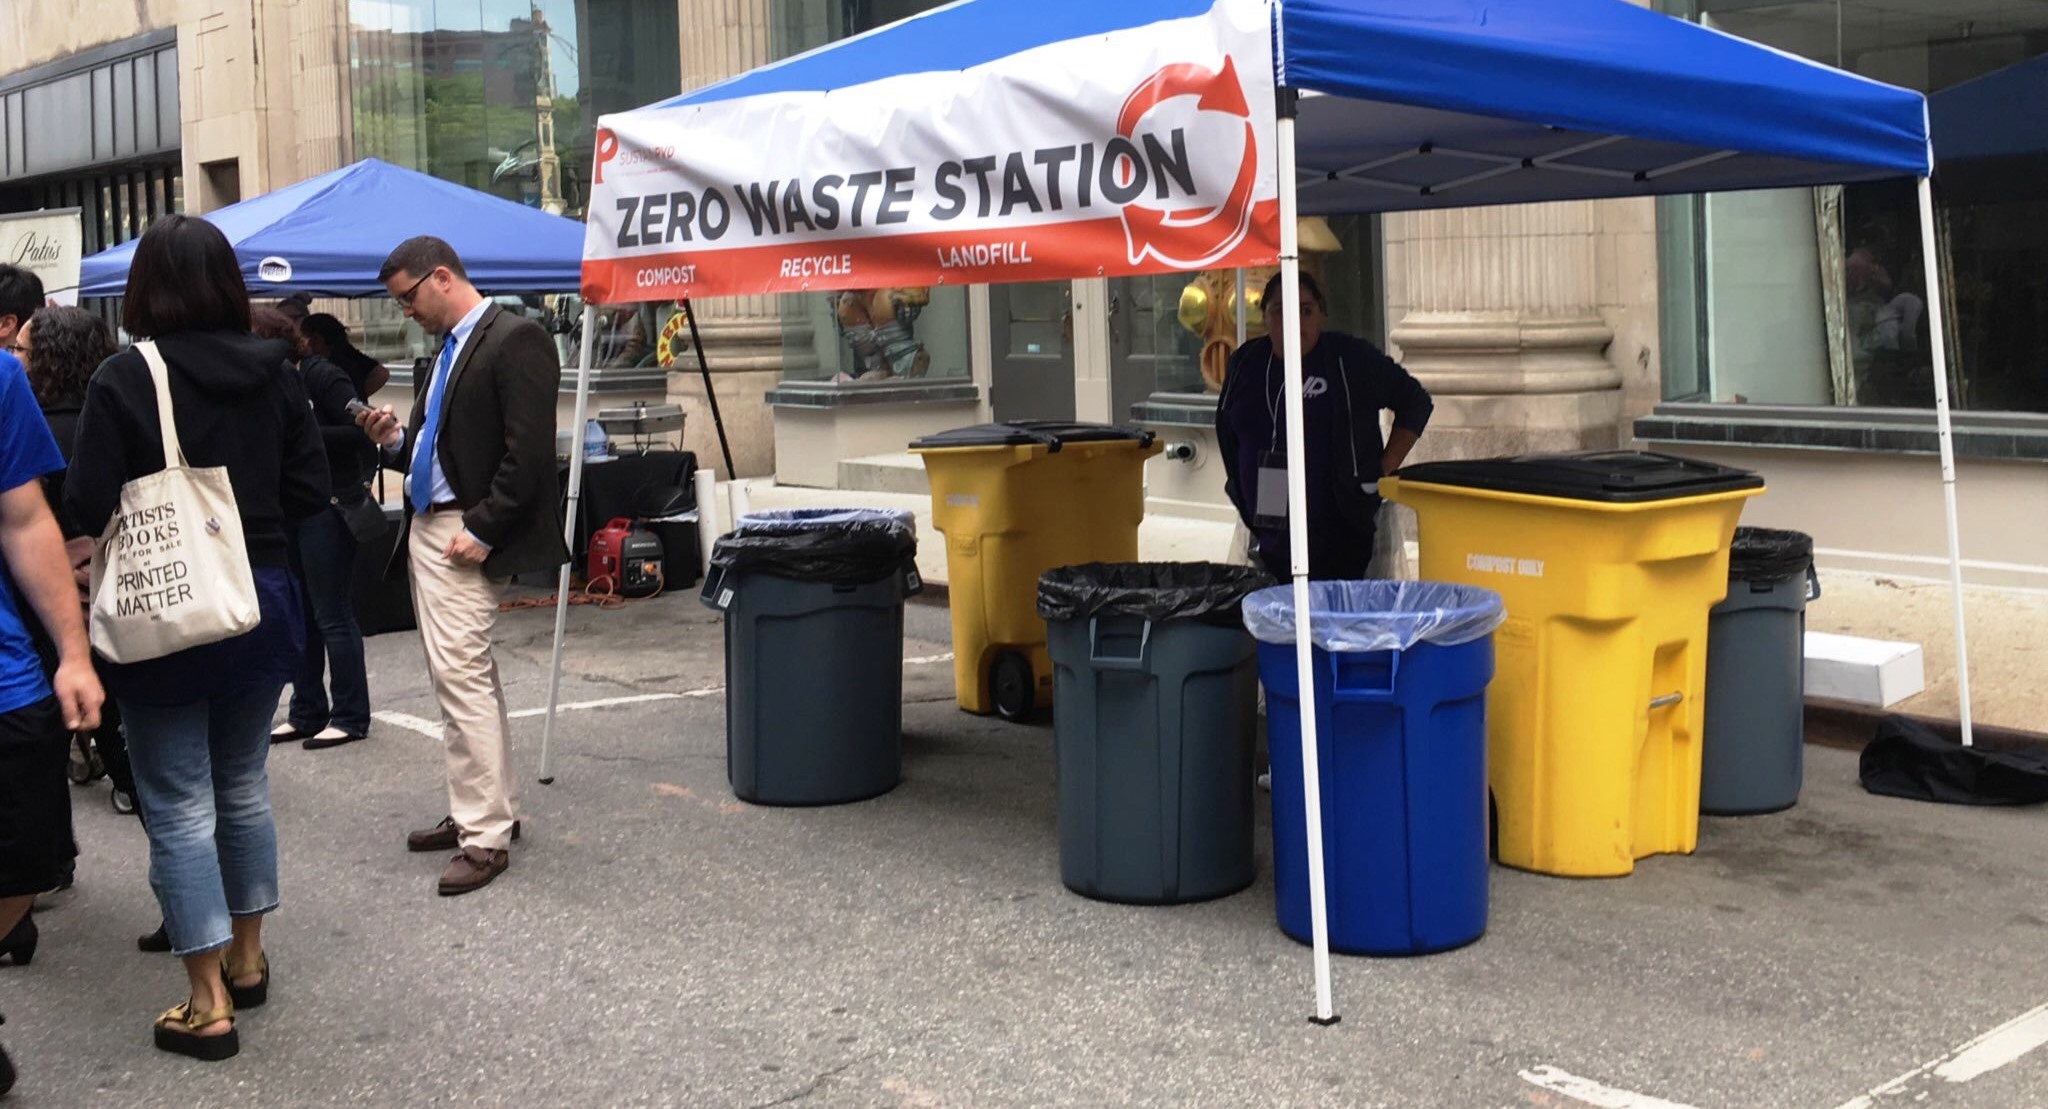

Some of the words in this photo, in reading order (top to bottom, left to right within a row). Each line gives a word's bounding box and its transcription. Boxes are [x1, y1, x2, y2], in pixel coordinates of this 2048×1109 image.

[616, 187, 731, 249] ZERO
[733, 167, 917, 237] WASTE
[929, 127, 1198, 221] STATION
[779, 253, 852, 279] RECYCLE
[937, 240, 1033, 269] LANDFILL
[636, 264, 696, 288] COMPOST
[132, 548, 152, 558] FOR
[159, 539, 183, 553] SALE
[116, 560, 188, 594] PRINTED
[1465, 553, 1517, 574] COMPOST
[116, 583, 194, 618] MATTER
